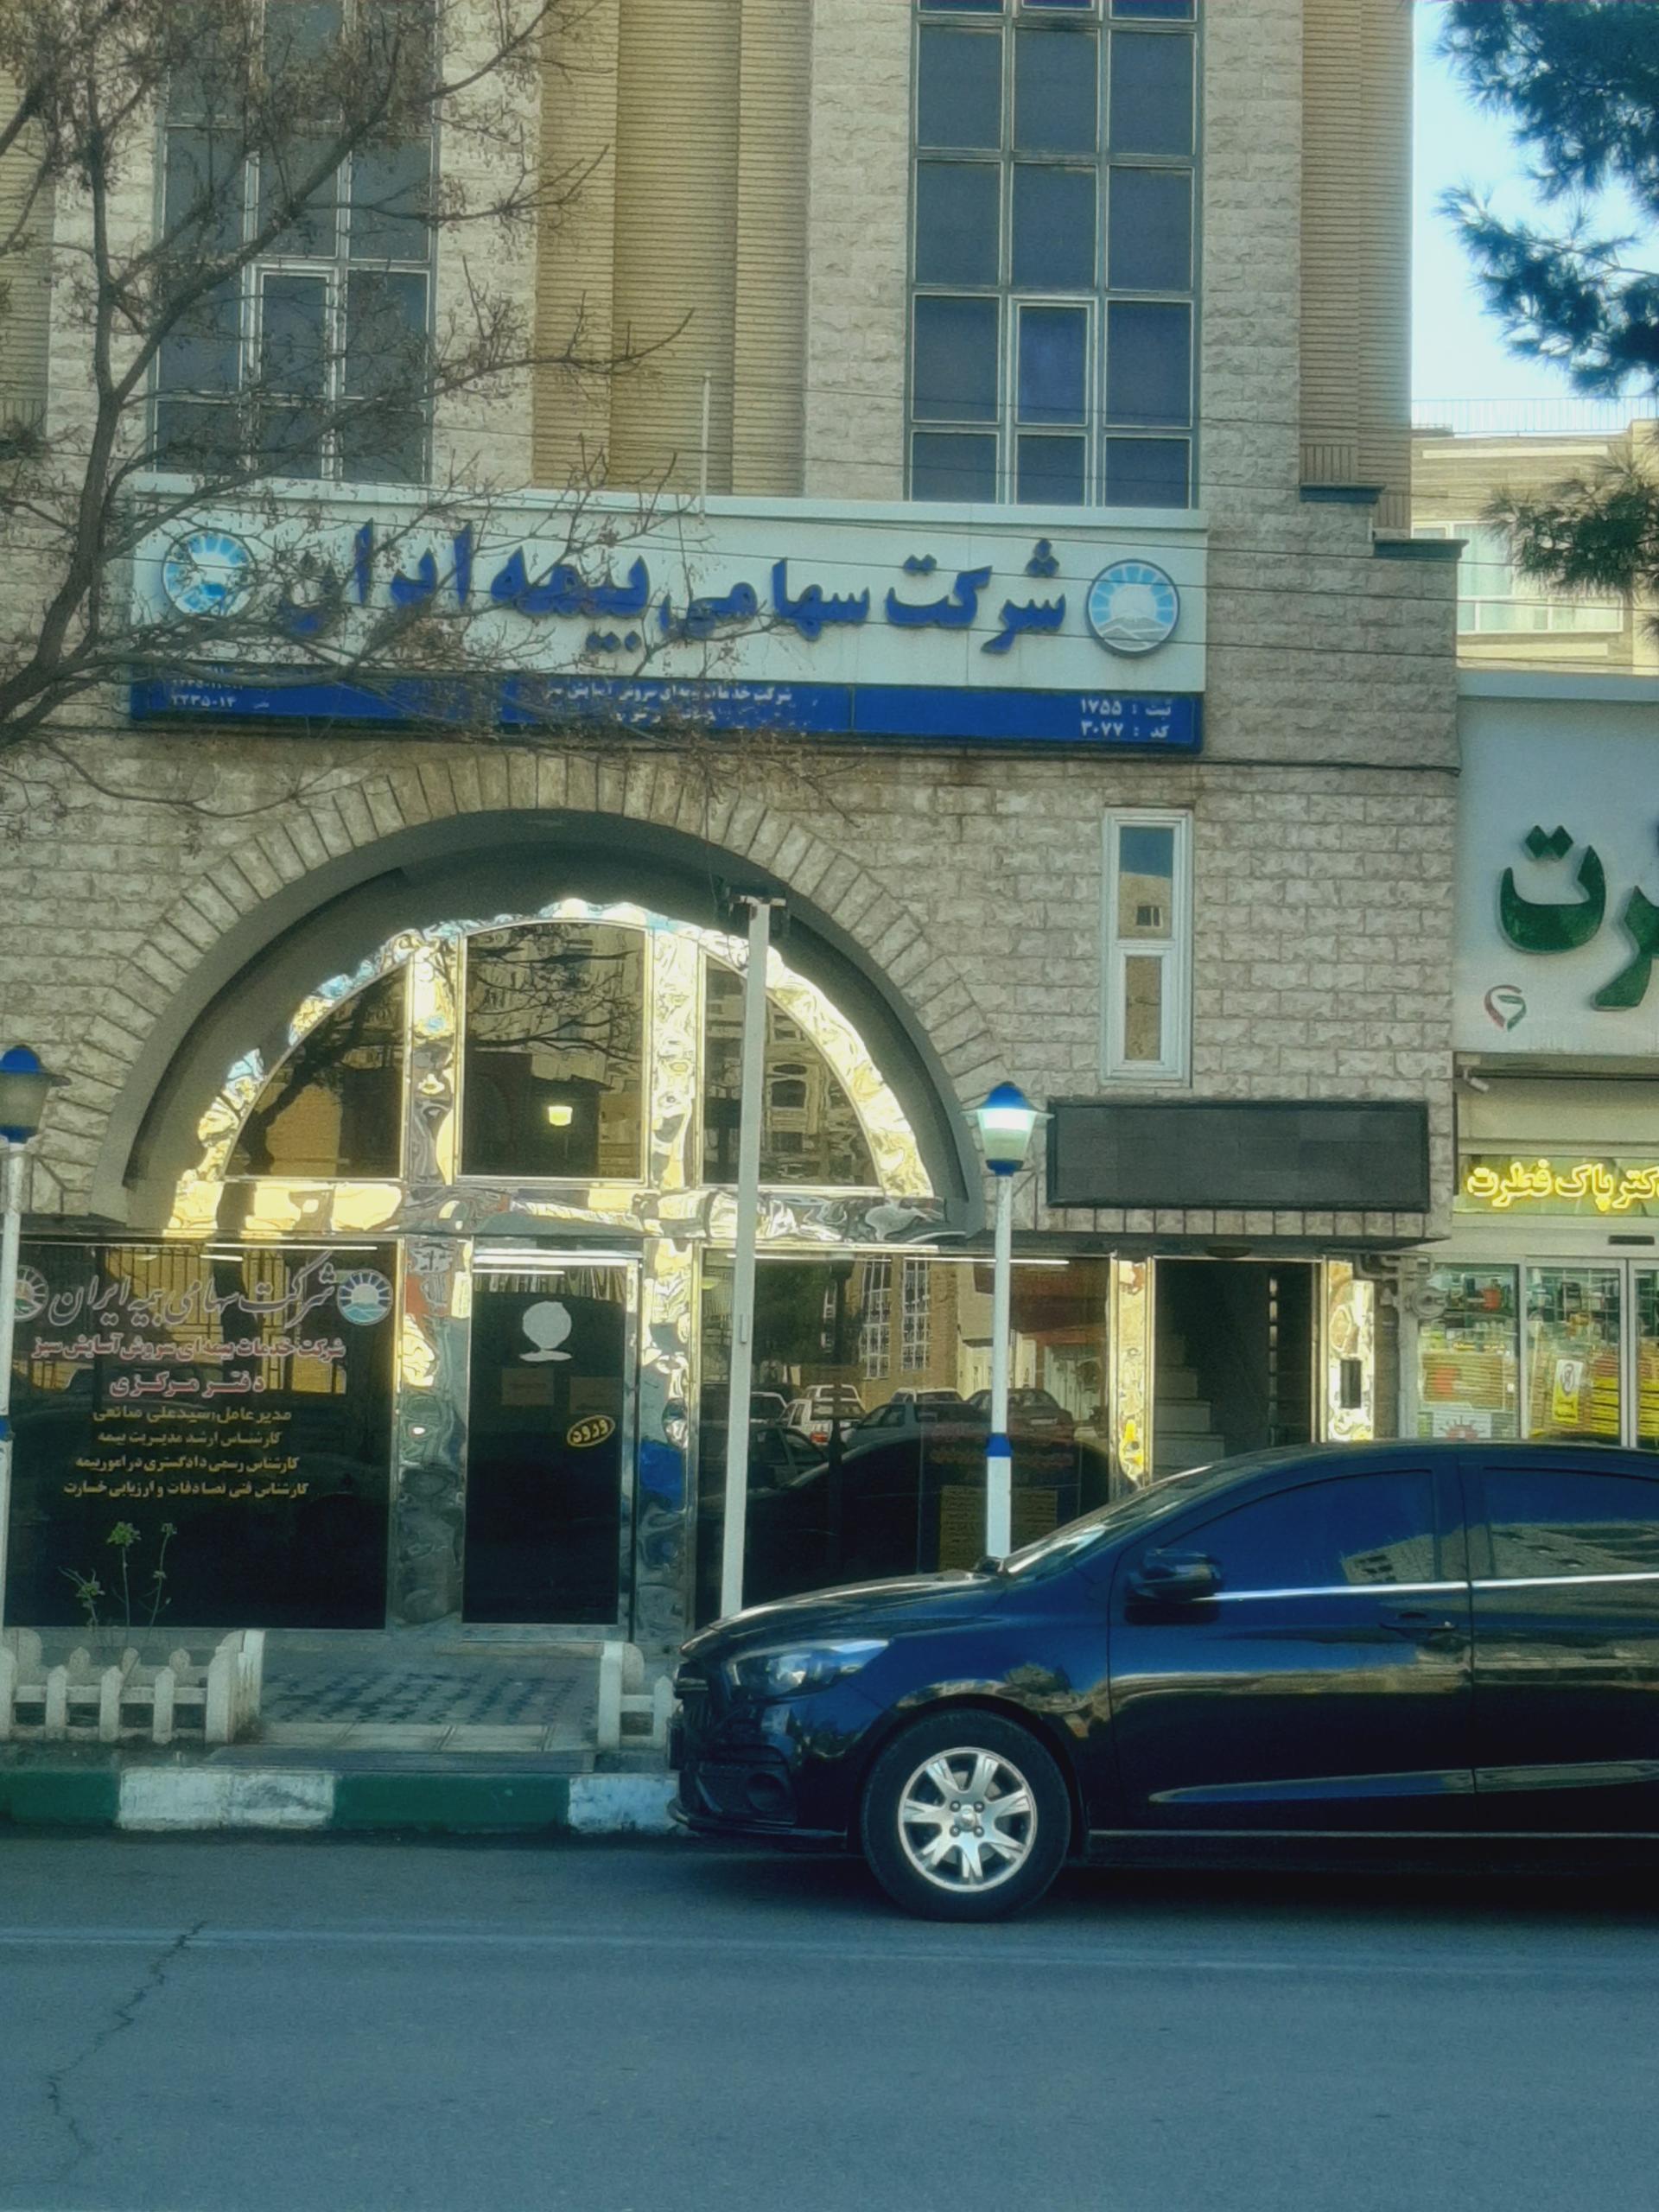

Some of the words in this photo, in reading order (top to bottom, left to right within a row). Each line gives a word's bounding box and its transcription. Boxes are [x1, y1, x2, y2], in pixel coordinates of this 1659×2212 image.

[490, 545, 650, 654] بیمه
[658, 556, 871, 643] سهامی
[884, 537, 1068, 655] شرکت
[753, 684, 792, 705] شرکت
[1081, 697, 1122, 716] ۱۷۵۵
[1145, 700, 1173, 721] ثبت
[1081, 720, 1124, 737] ۳۰۷۷
[1150, 724, 1170, 739] کد
[1467, 1159, 1552, 1208] فطرت
[1554, 1163, 1614, 1211] پاک
[1611, 1166, 1659, 1209] کتر
[48, 1274, 131, 1327] ایران
[162, 1274, 241, 1326] سهامی
[238, 1249, 336, 1331] شرکت
[127, 1287, 165, 1328] بیمه
[31, 1336, 63, 1359] سبز
[63, 1332, 124, 1360] آسایش
[119, 1335, 178, 1361] سروش
[235, 1337, 297, 1357] خدمات
[297, 1338, 346, 1363] شرکت
[109, 1370, 200, 1398] مرکزی
[201, 1370, 266, 1398] دفتر
[256, 1409, 292, 1424] مدیر
[98, 1431, 127, 1446] بیمه
[128, 1431, 183, 1446] مدیریت
[184, 1430, 219, 1447] ارشد
[220, 1430, 283, 1448] کارشناس
[571, 1419, 609, 1444] ورود
[127, 1457, 143, 1471] در
[143, 1455, 207, 1472] دادگستری
[208, 1459, 245, 1473] رسمی
[245, 1456, 300, 1474] کارشناس
[63, 1480, 107, 1498] خسارت
[228, 1480, 252, 1499] فنی
[254, 1482, 309, 1498] کارشناس
